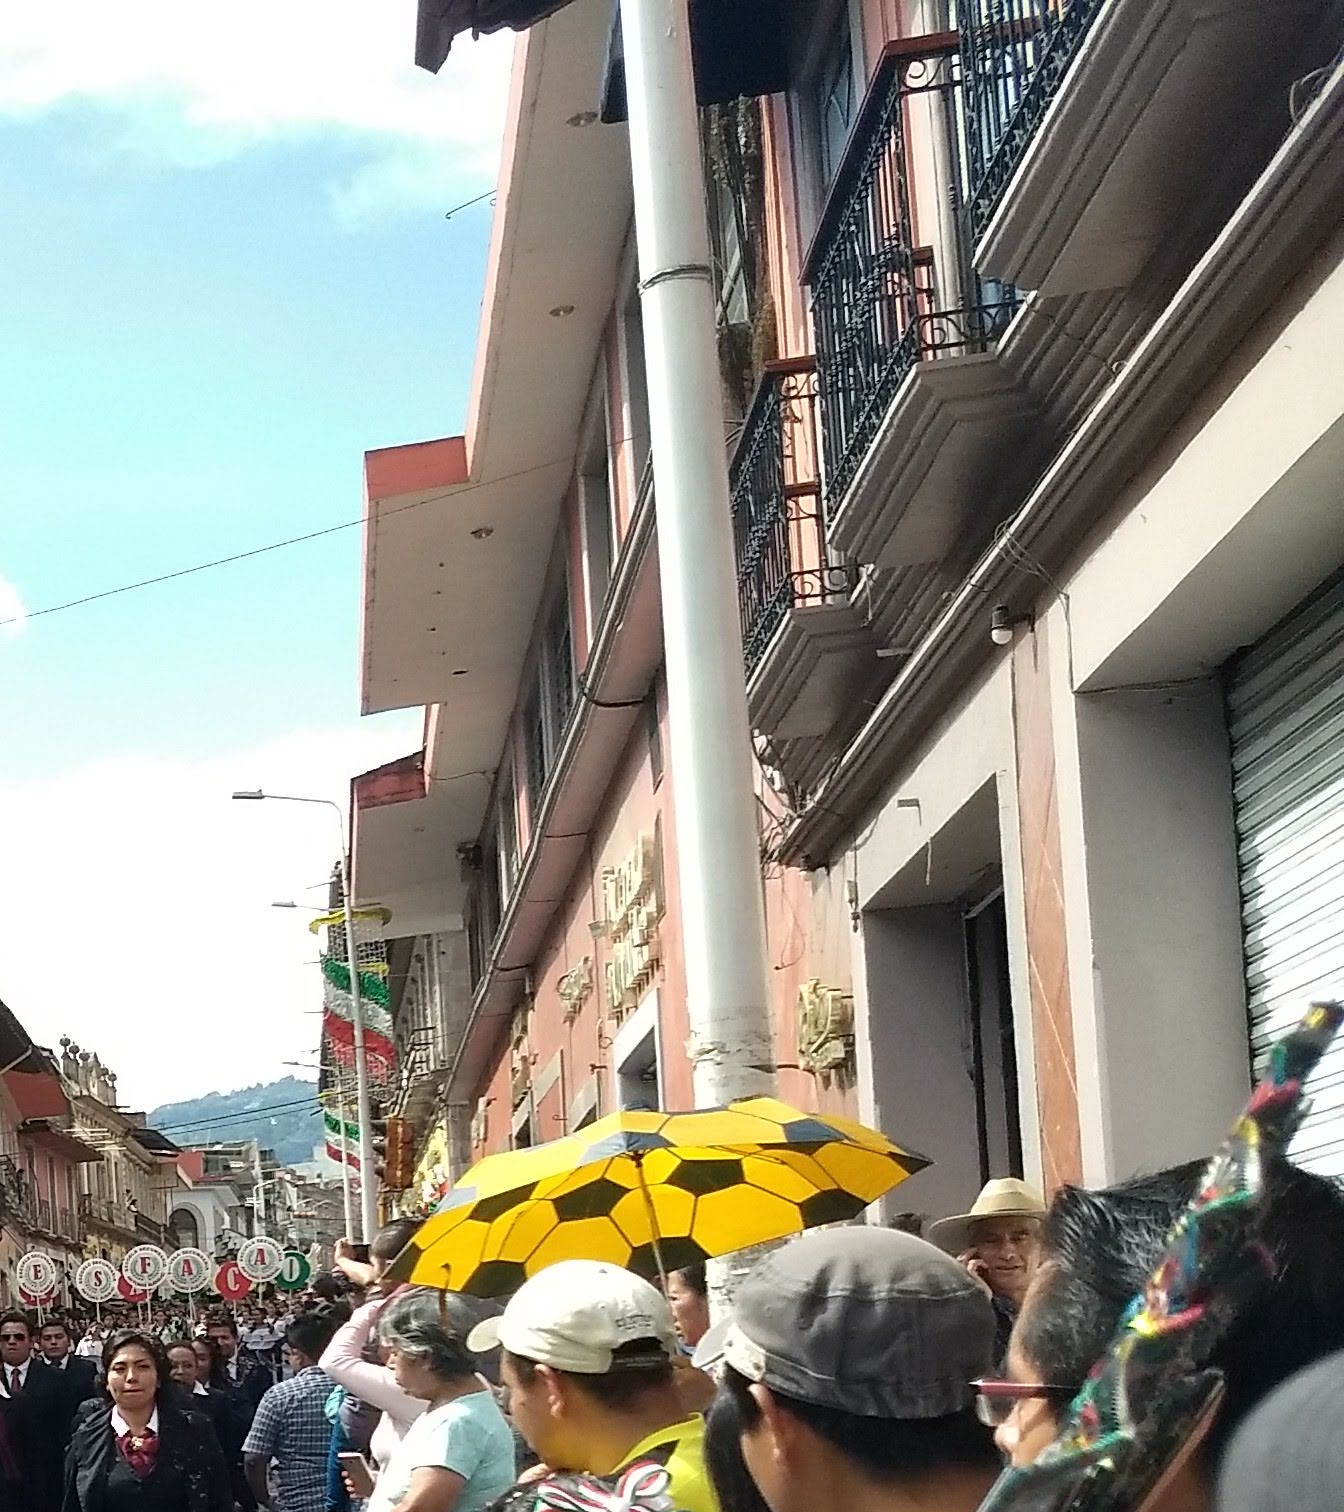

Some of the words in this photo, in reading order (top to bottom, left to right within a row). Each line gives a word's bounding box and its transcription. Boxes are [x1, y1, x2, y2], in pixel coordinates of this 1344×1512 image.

[140, 1256, 151, 1274] F
[254, 1247, 267, 1266] A
[32, 1264, 43, 1281] E
[181, 1258, 193, 1276] A
[94, 1270, 103, 1287] S
[226, 1266, 240, 1292] C
